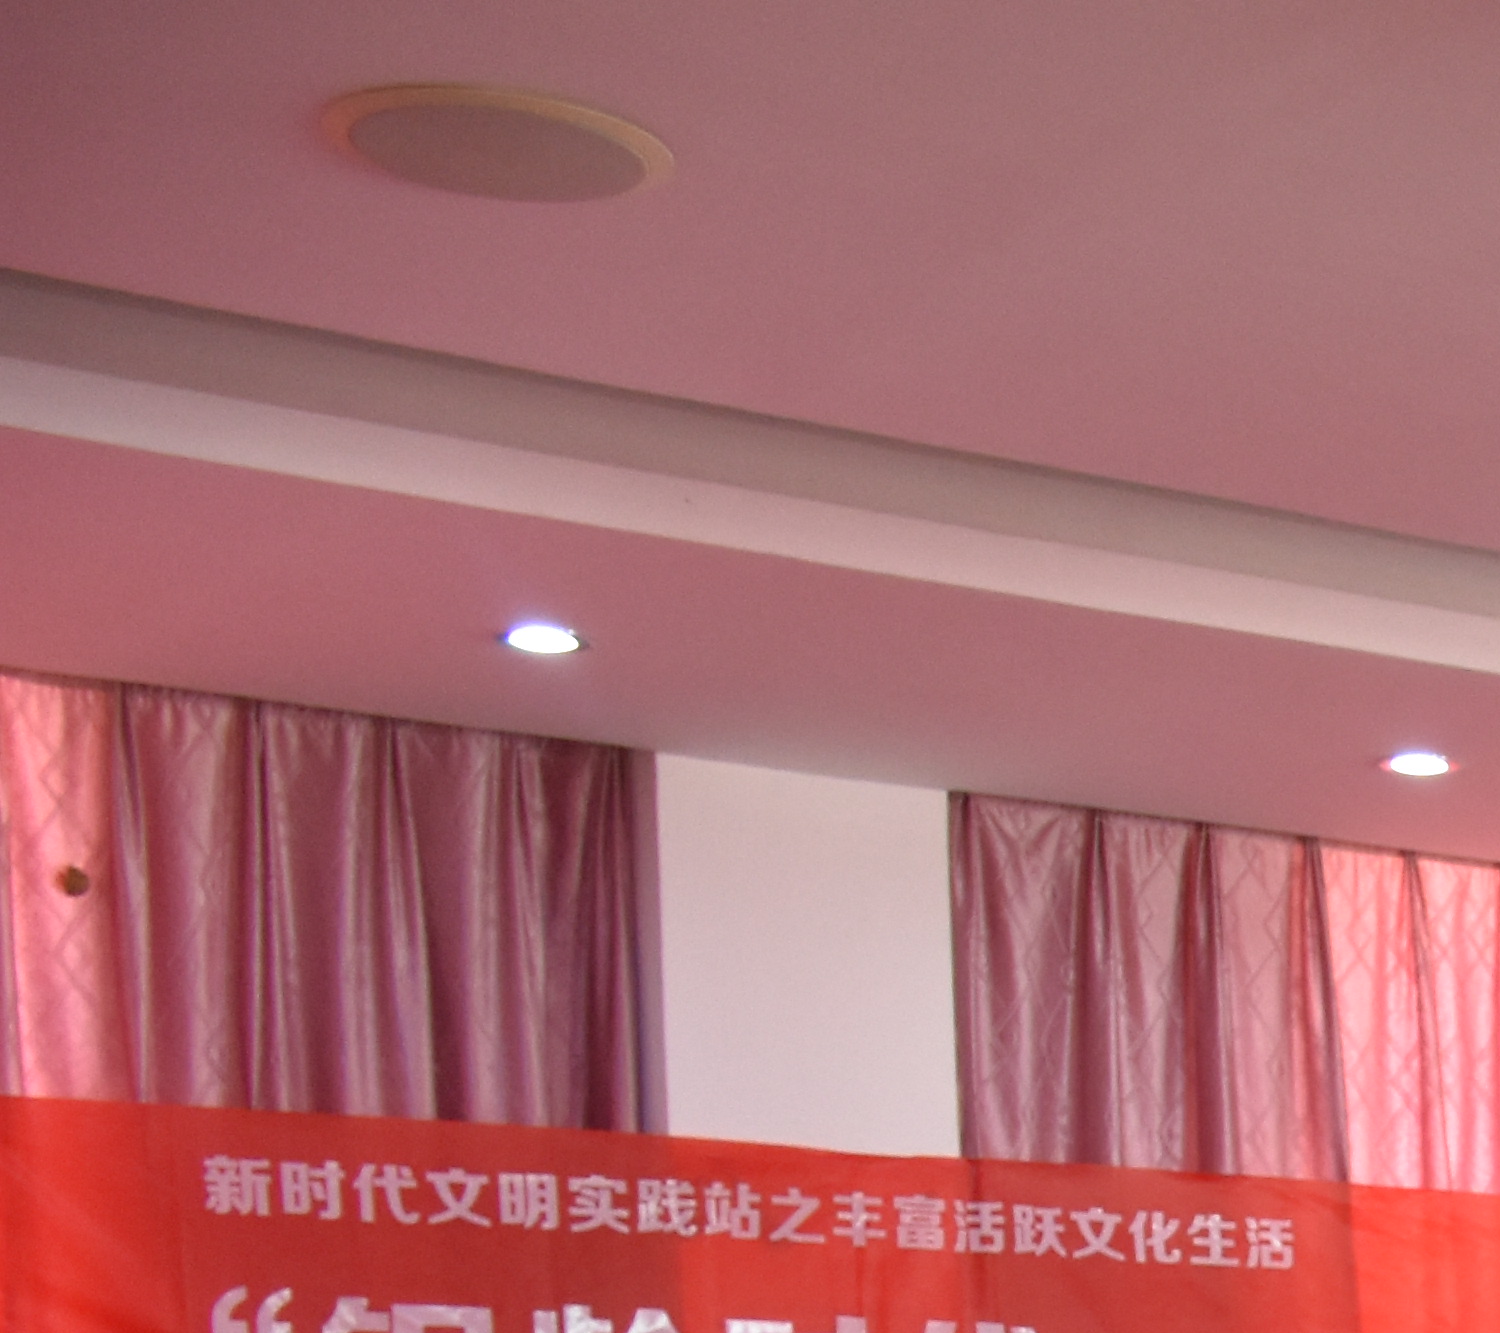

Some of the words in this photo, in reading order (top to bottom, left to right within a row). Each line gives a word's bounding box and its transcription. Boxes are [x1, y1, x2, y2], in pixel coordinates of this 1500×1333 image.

[203, 1155, 1296, 1270] 新时代文明实践站之丰富活跃文化生活
